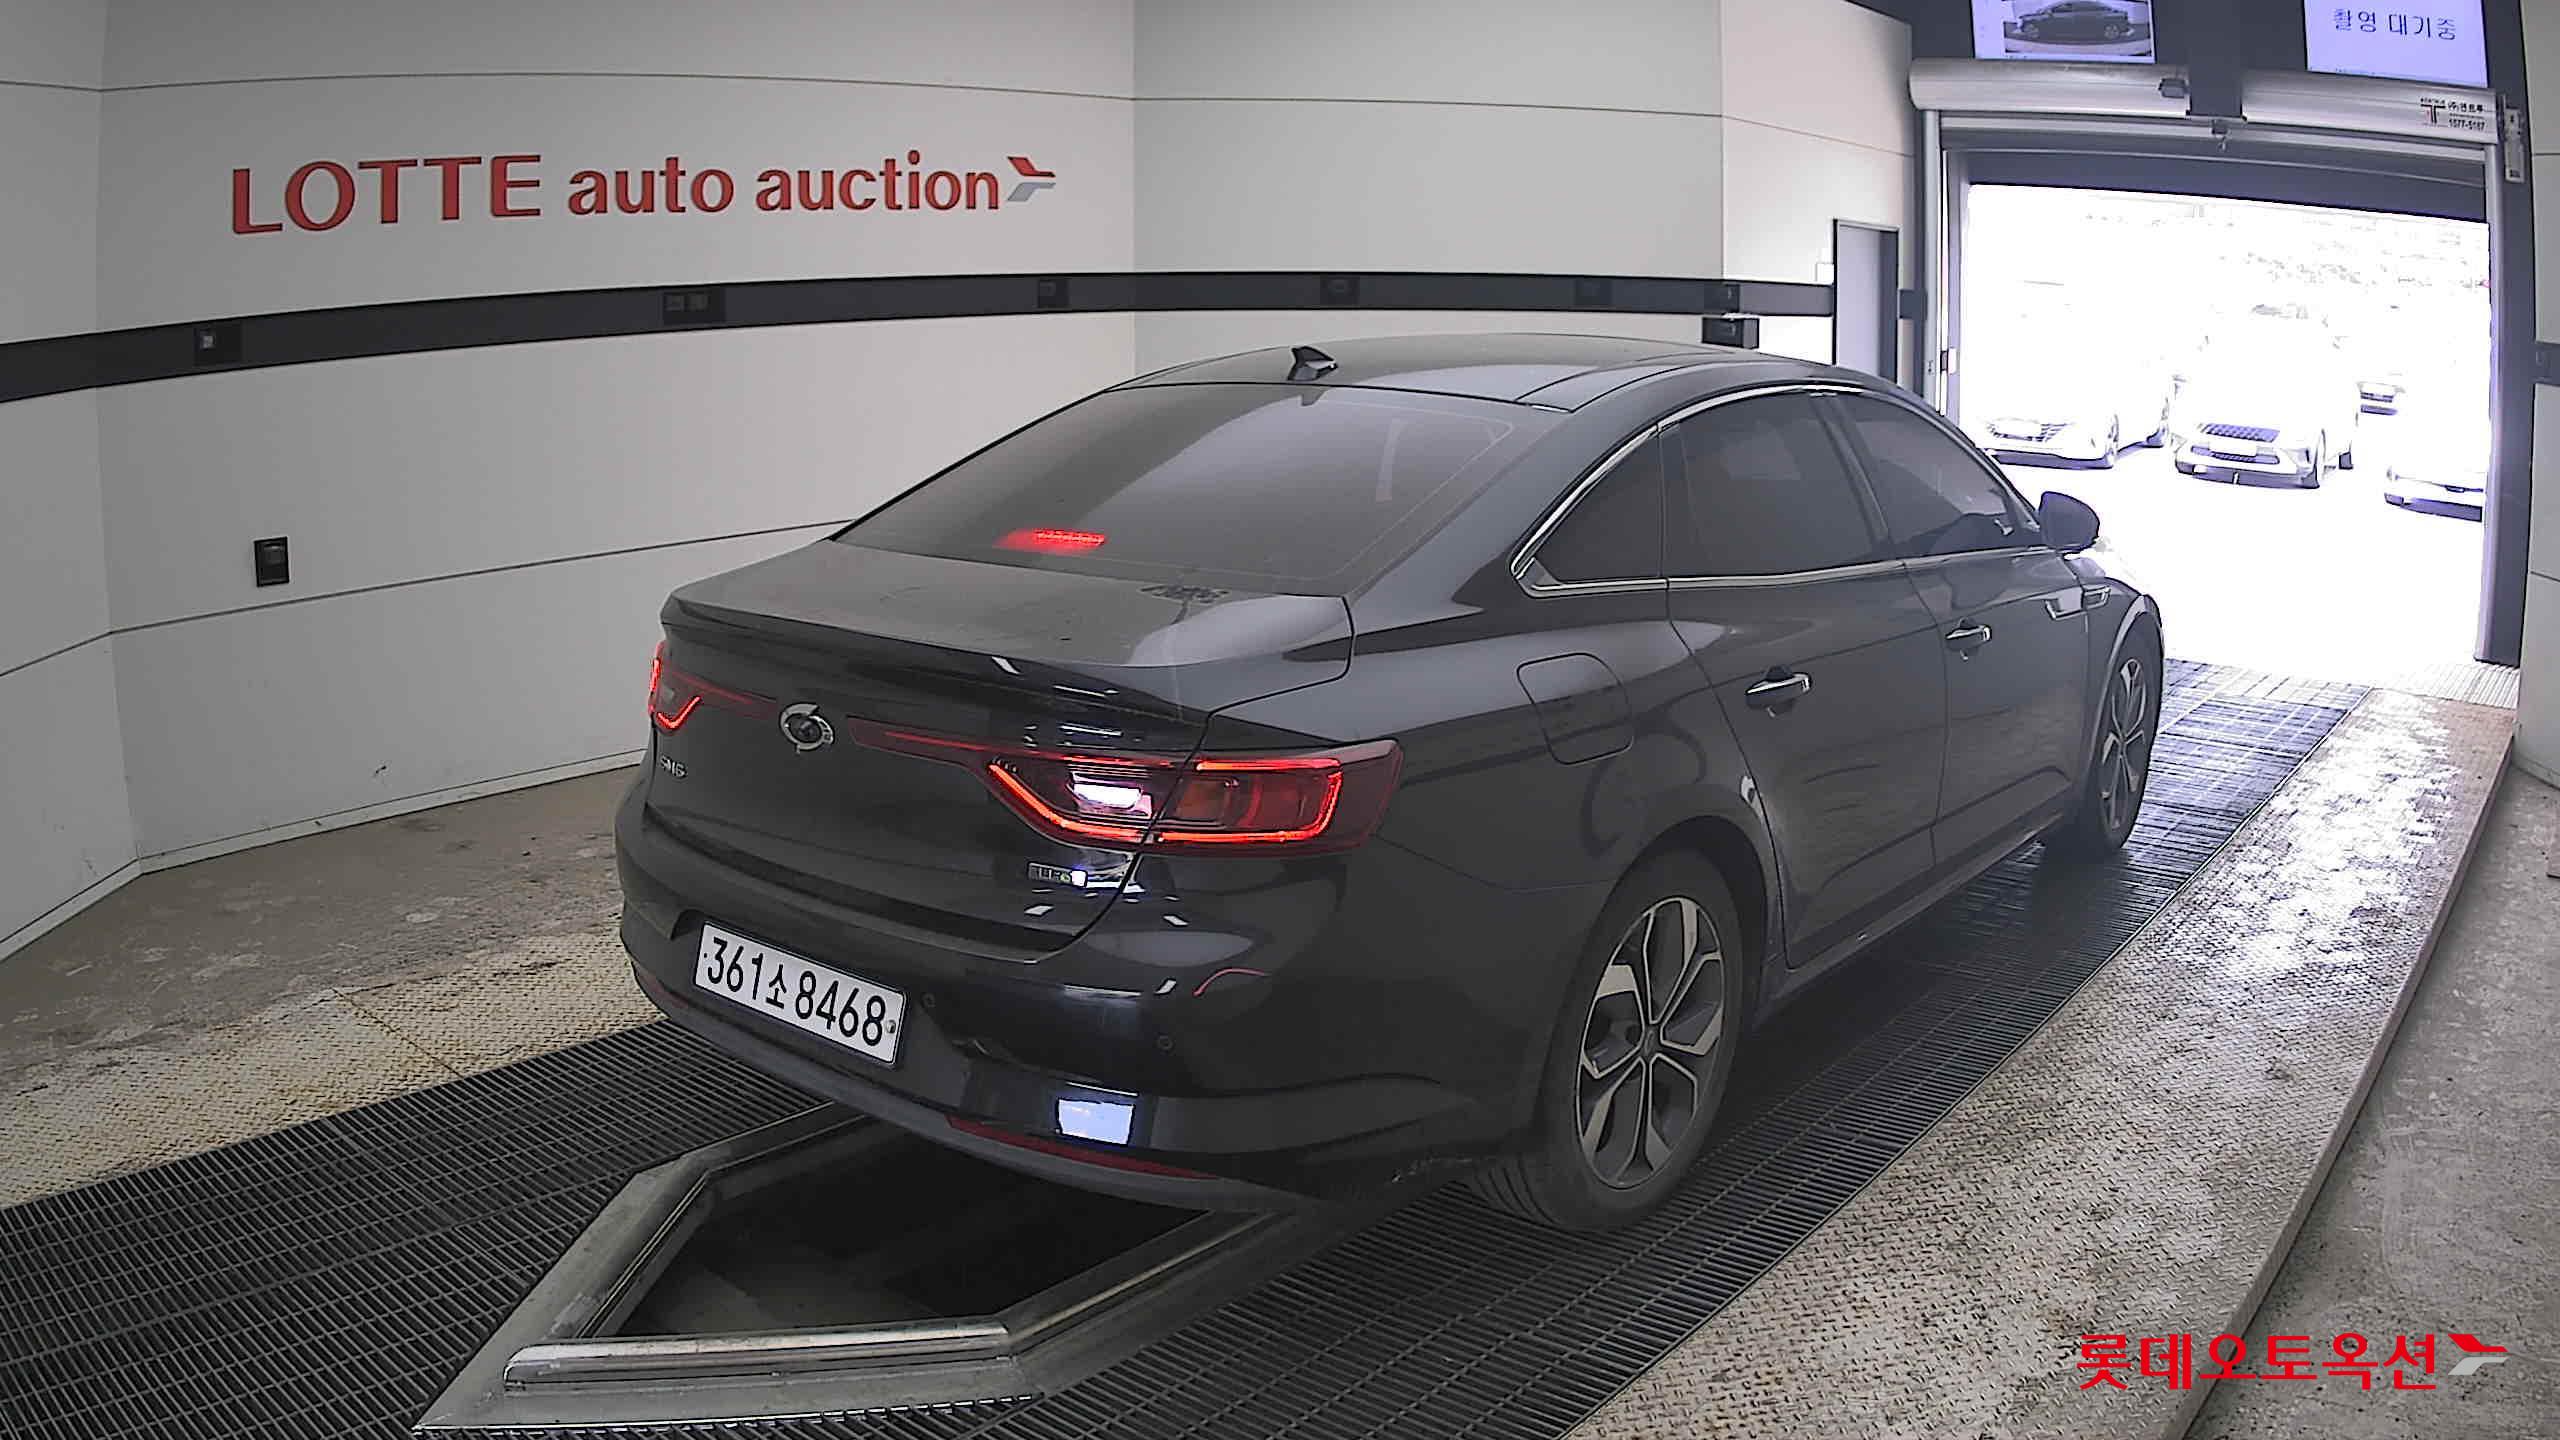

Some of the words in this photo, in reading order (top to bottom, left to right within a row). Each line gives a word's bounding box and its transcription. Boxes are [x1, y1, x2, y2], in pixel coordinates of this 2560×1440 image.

[2388, 14, 2456, 40] 대기중
[232, 154, 543, 235] LOTTE
[568, 156, 735, 216] auto
[755, 150, 1001, 212] auction
[707, 936, 886, 1046] 361소8468
